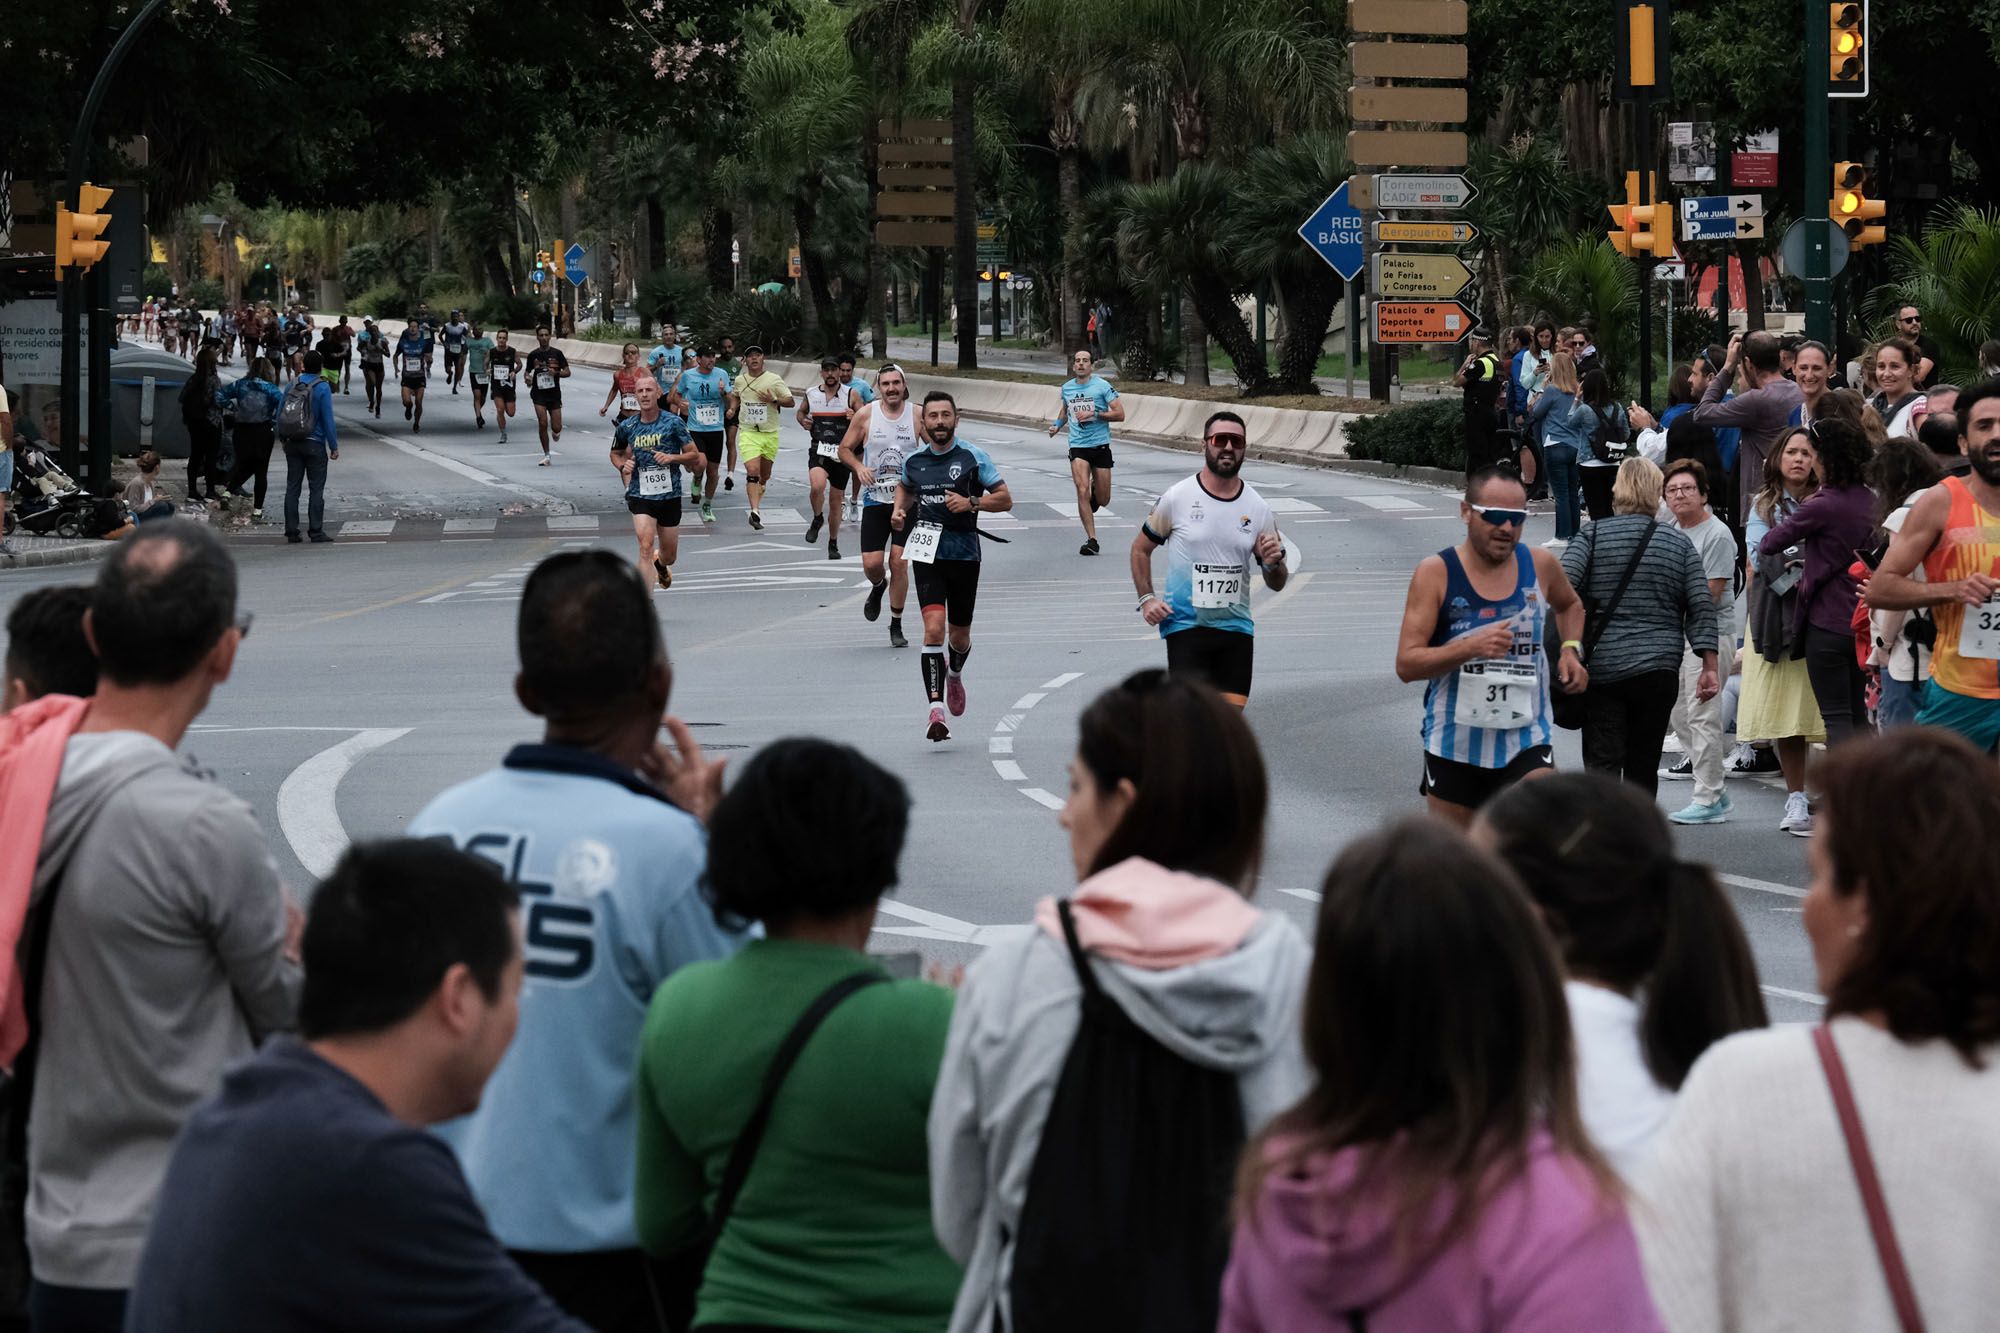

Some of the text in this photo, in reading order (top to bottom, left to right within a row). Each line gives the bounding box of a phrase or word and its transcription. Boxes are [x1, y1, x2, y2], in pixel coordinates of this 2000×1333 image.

[1382, 180, 1458, 190] Torremolinos
[1685, 200, 1729, 219] P SAN JUAN
[1331, 217, 1362, 229] RED
[1383, 226, 1448, 238] Aeropuerto
[1687, 221, 1736, 241] P ANDALUCÍA
[1318, 230, 1364, 244] BÁSIC
[1383, 259, 1415, 268] Palacio
[1383, 271, 1424, 280] de Ferias
[1393, 282, 1437, 292] Congresos
[1380, 306, 1435, 314] Palacio de
[1380, 318, 1423, 328] Deportes
[1416, 329, 1454, 339] Carpena
[747, 408, 764, 416] 3365
[1073, 404, 1091, 412] 6703
[633, 433, 662, 448] ARMY
[645, 473, 667, 484] 1636
[1194, 564, 1209, 574] 43
[1198, 579, 1239, 594] 11720
[1979, 612, 2000, 631] 32
[1463, 663, 1484, 675] 43
[1486, 684, 1508, 702] 31
